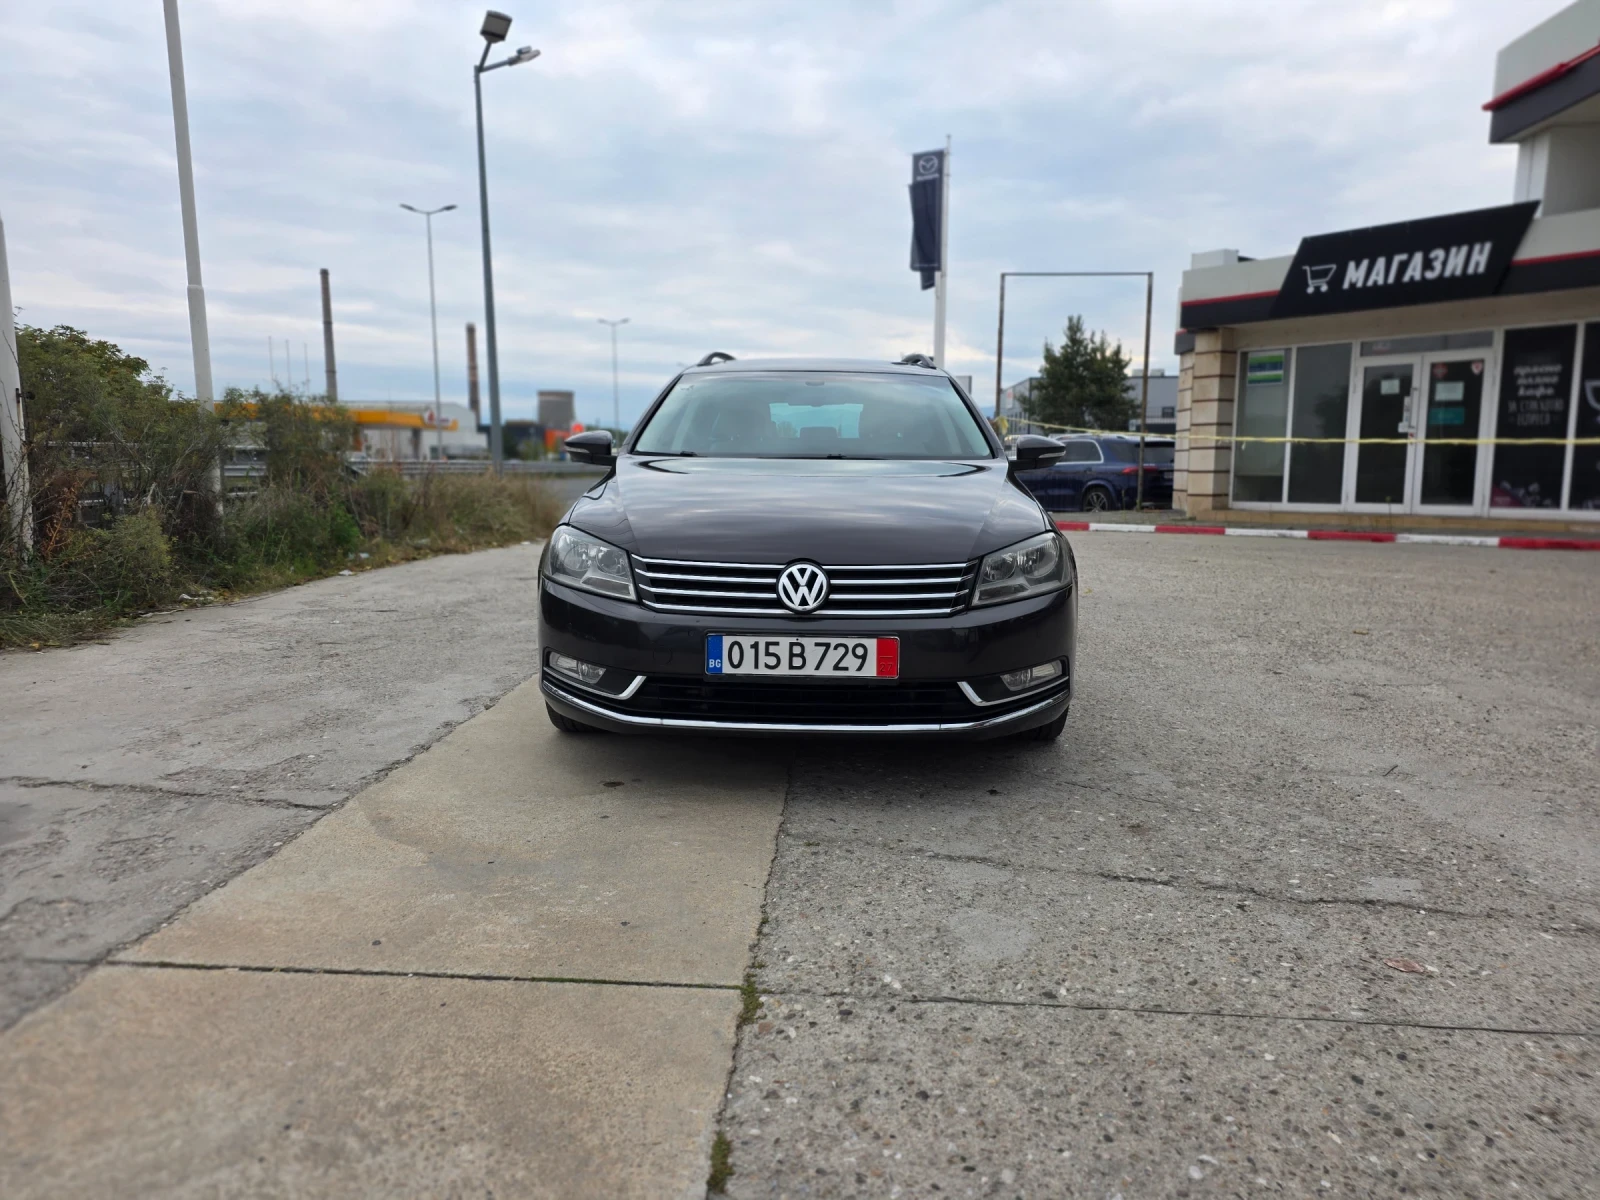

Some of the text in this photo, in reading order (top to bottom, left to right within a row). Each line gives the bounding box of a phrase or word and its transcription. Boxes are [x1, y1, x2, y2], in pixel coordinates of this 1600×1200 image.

[1342, 241, 1492, 290] МАГАЗИН
[708, 658, 722, 669] BG
[727, 640, 868, 671] 015B729
